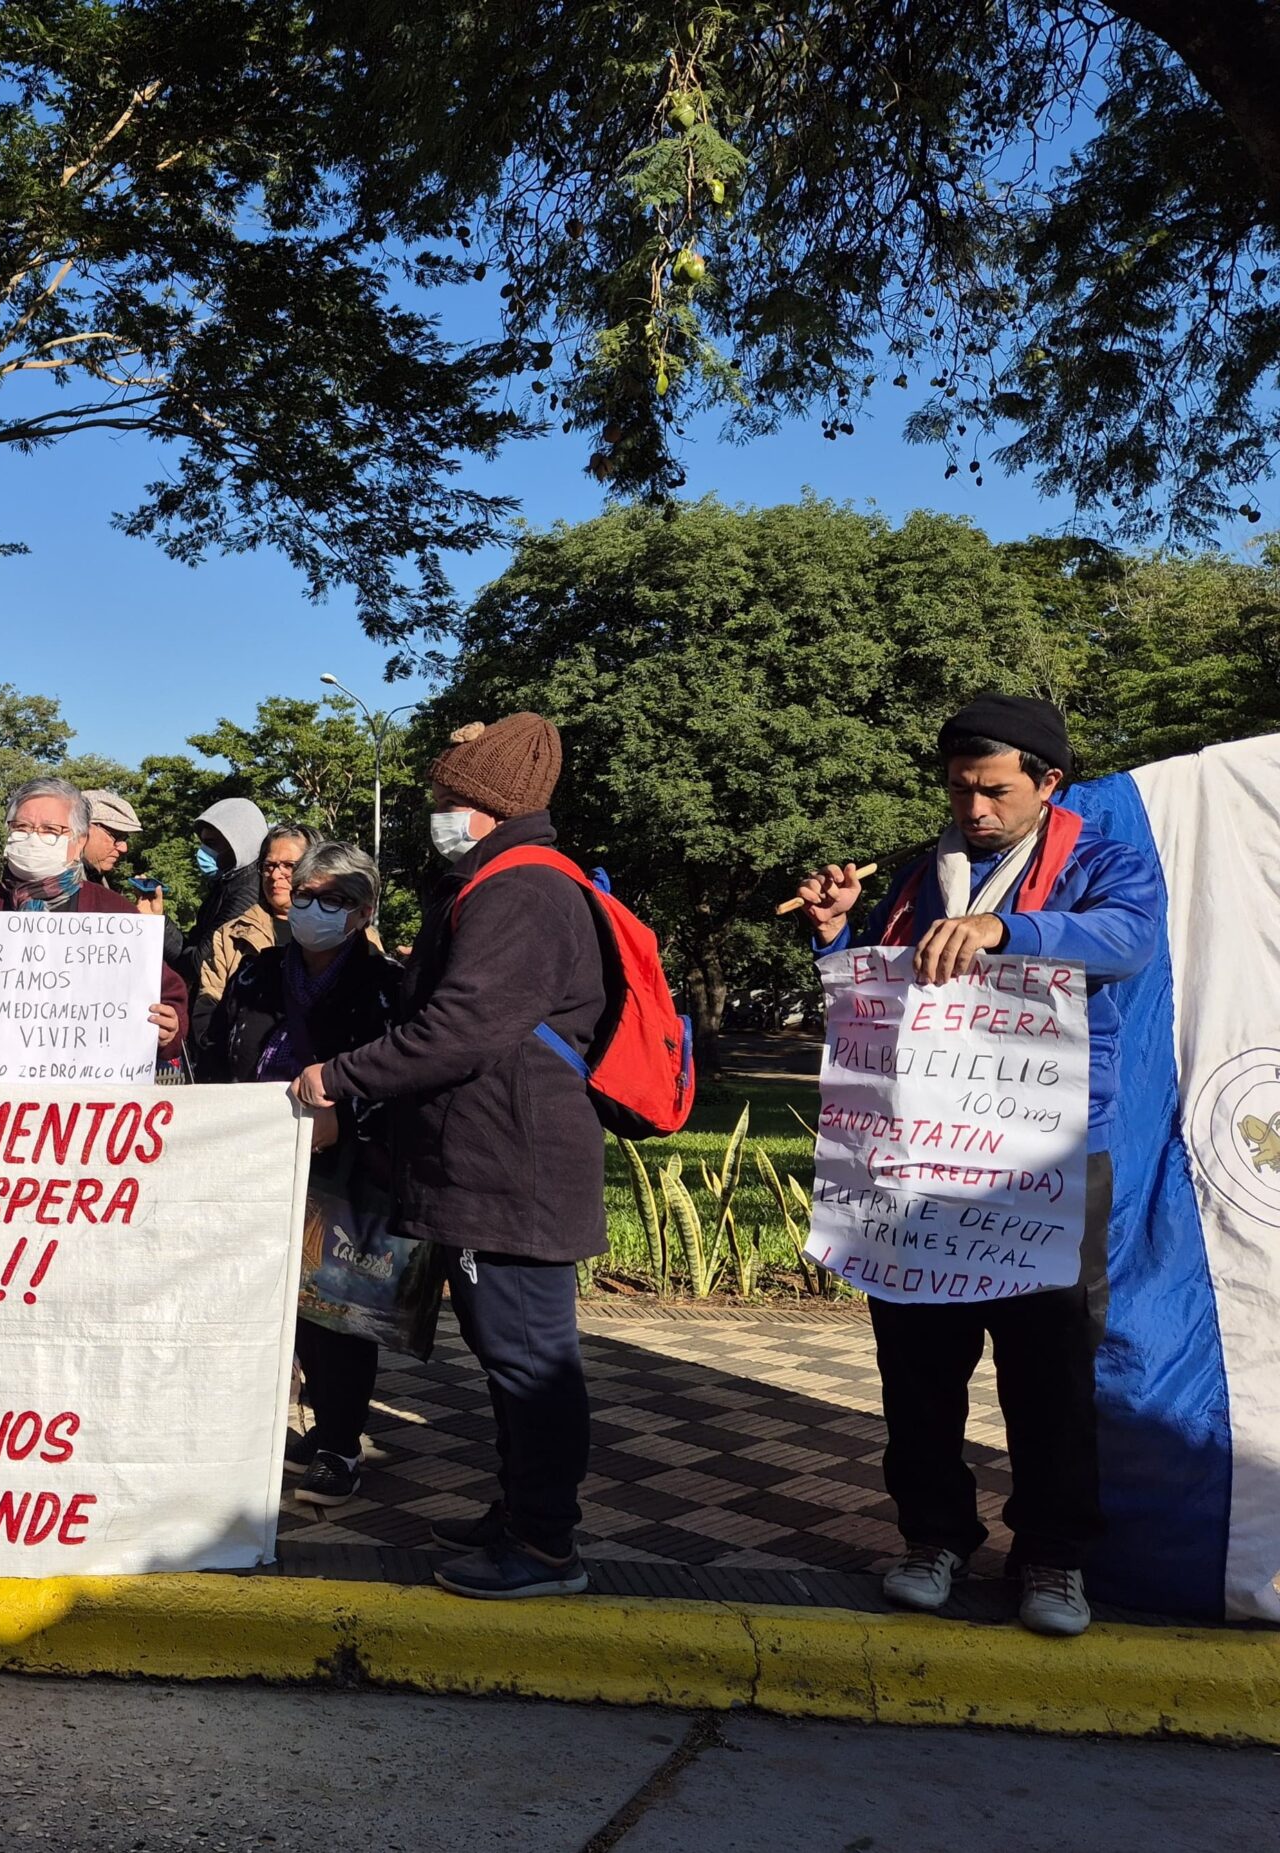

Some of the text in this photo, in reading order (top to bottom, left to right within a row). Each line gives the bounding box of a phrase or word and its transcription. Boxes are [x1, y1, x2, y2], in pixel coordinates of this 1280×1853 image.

[7, 914, 144, 937] ONCOLOGICOS
[21, 944, 46, 963] NO
[64, 944, 132, 965] ESPERA
[853, 953, 1073, 998] EL NCER
[19, 1025, 87, 1048] VIVIR
[911, 1002, 1061, 1039] ESPERA
[832, 1036, 1060, 1086] PALBOCICLIB
[821, 1103, 1004, 1154] SANDOSTATIN
[862, 1219, 1037, 1269] TRIMESTRAL
[959, 1207, 1065, 1247] DEPOT
